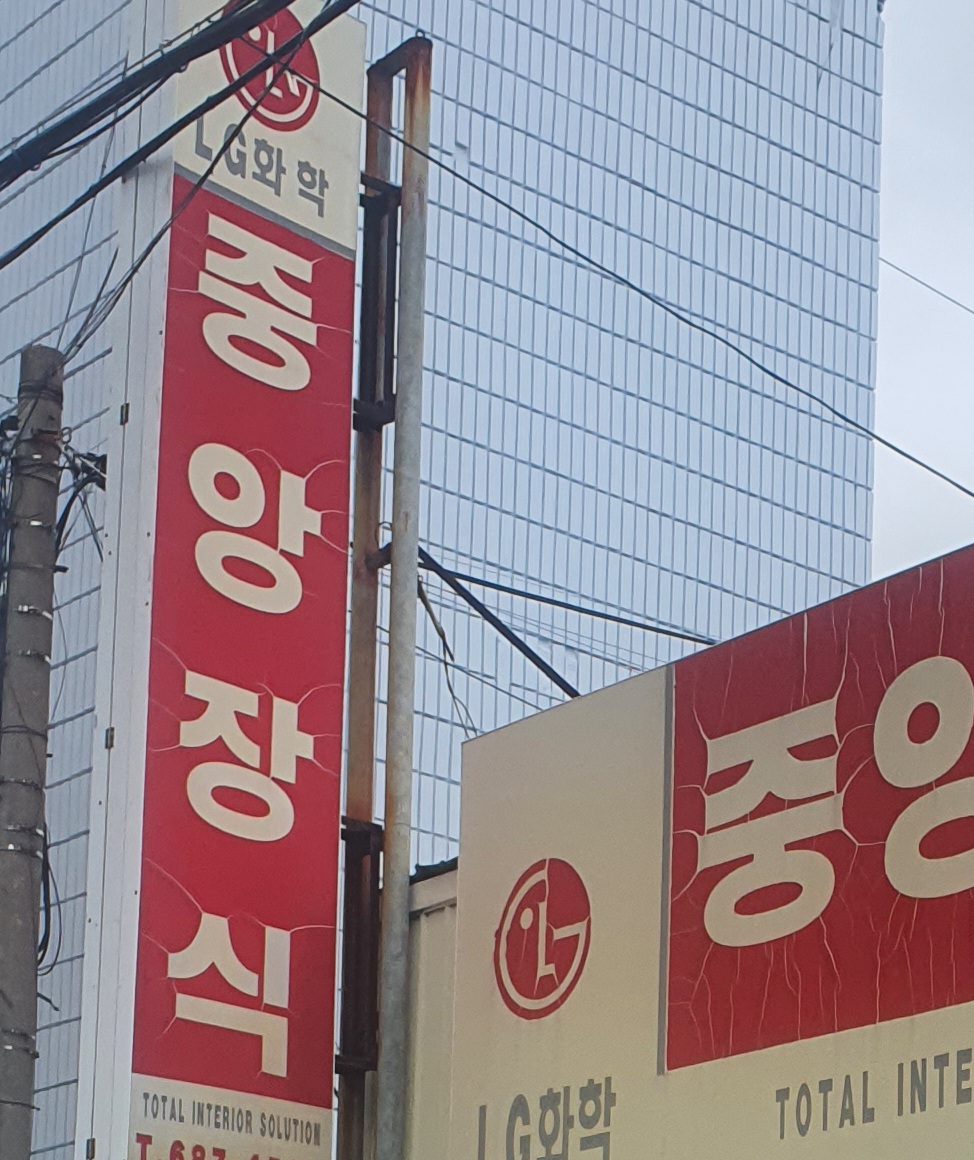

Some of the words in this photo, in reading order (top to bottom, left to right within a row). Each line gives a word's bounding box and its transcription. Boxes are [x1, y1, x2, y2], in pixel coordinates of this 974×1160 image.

[194, 114, 330, 218] LG화학
[167, 210, 322, 1078] 중앙장식
[142, 1091, 185, 1124] TOTAL
[191, 1101, 254, 1135] INTERIOR
[259, 1111, 322, 1147] SOLUTION
[775, 1071, 876, 1141] TOTAL
